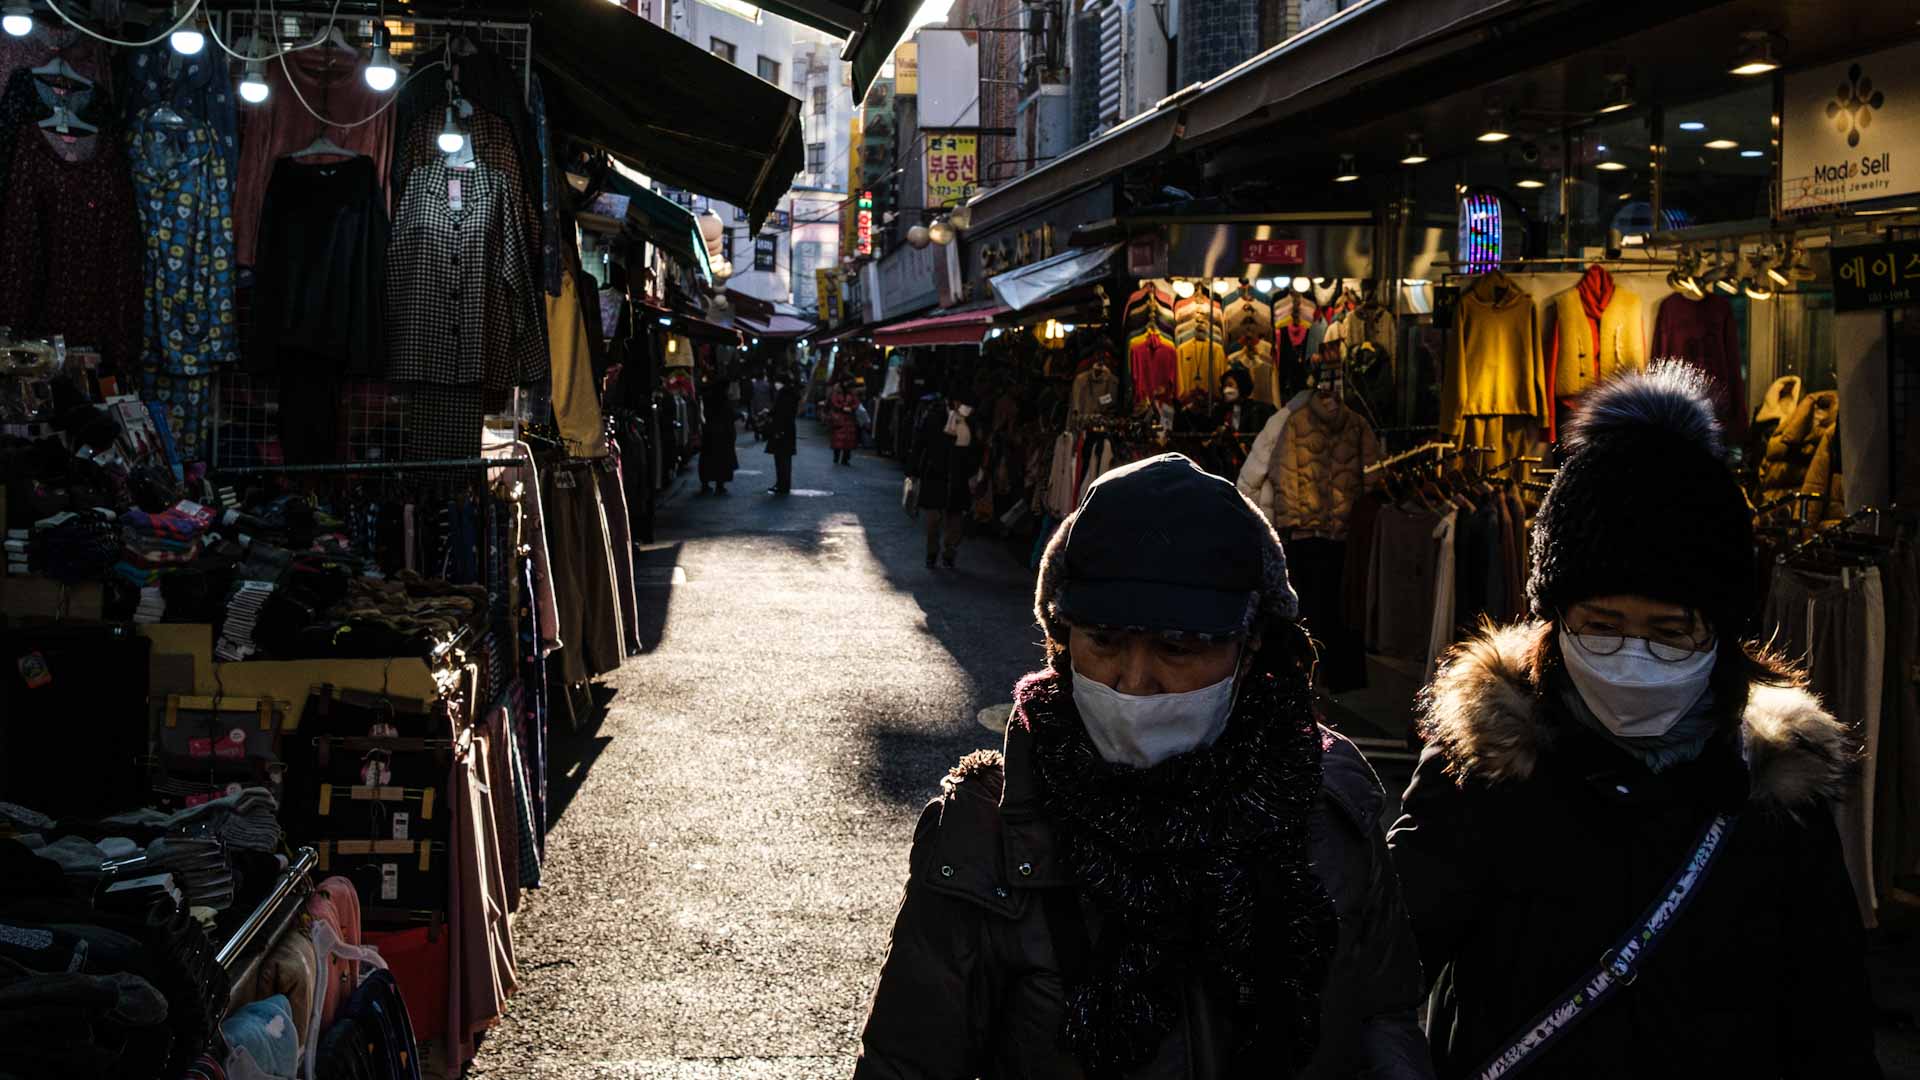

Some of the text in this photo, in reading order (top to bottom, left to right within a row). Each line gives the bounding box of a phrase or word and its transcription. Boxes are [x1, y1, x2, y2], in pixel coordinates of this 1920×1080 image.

[930, 154, 974, 182] 부동산
[1814, 152, 1890, 184] Made Sell
[1849, 179, 1890, 192] Jewelry
